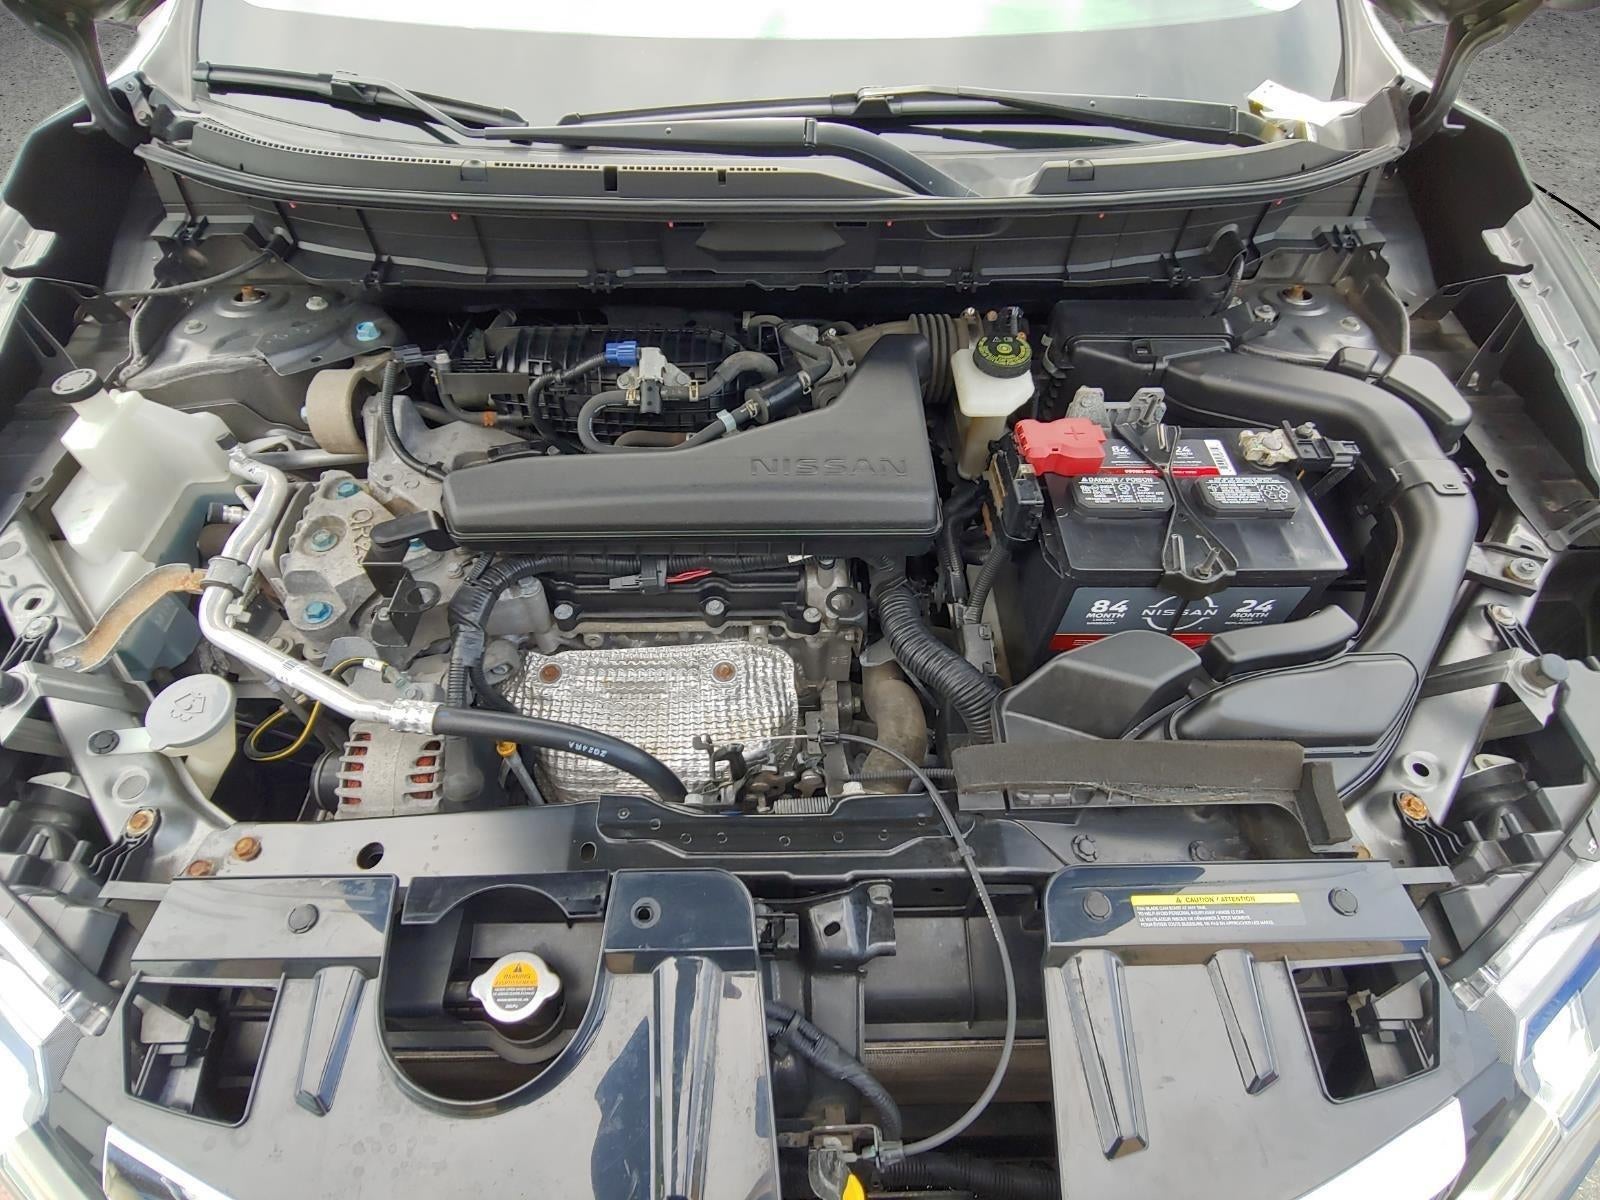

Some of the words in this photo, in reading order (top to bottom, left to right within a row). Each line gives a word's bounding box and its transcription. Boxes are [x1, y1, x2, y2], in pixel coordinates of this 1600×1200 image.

[1111, 445, 1129, 453] 84
[1175, 445, 1192, 453] 24
[751, 457, 908, 477] NISSAN
[1090, 599, 1130, 613] 84
[1235, 599, 1277, 613] 24
[1141, 608, 1219, 616] NISSAN
